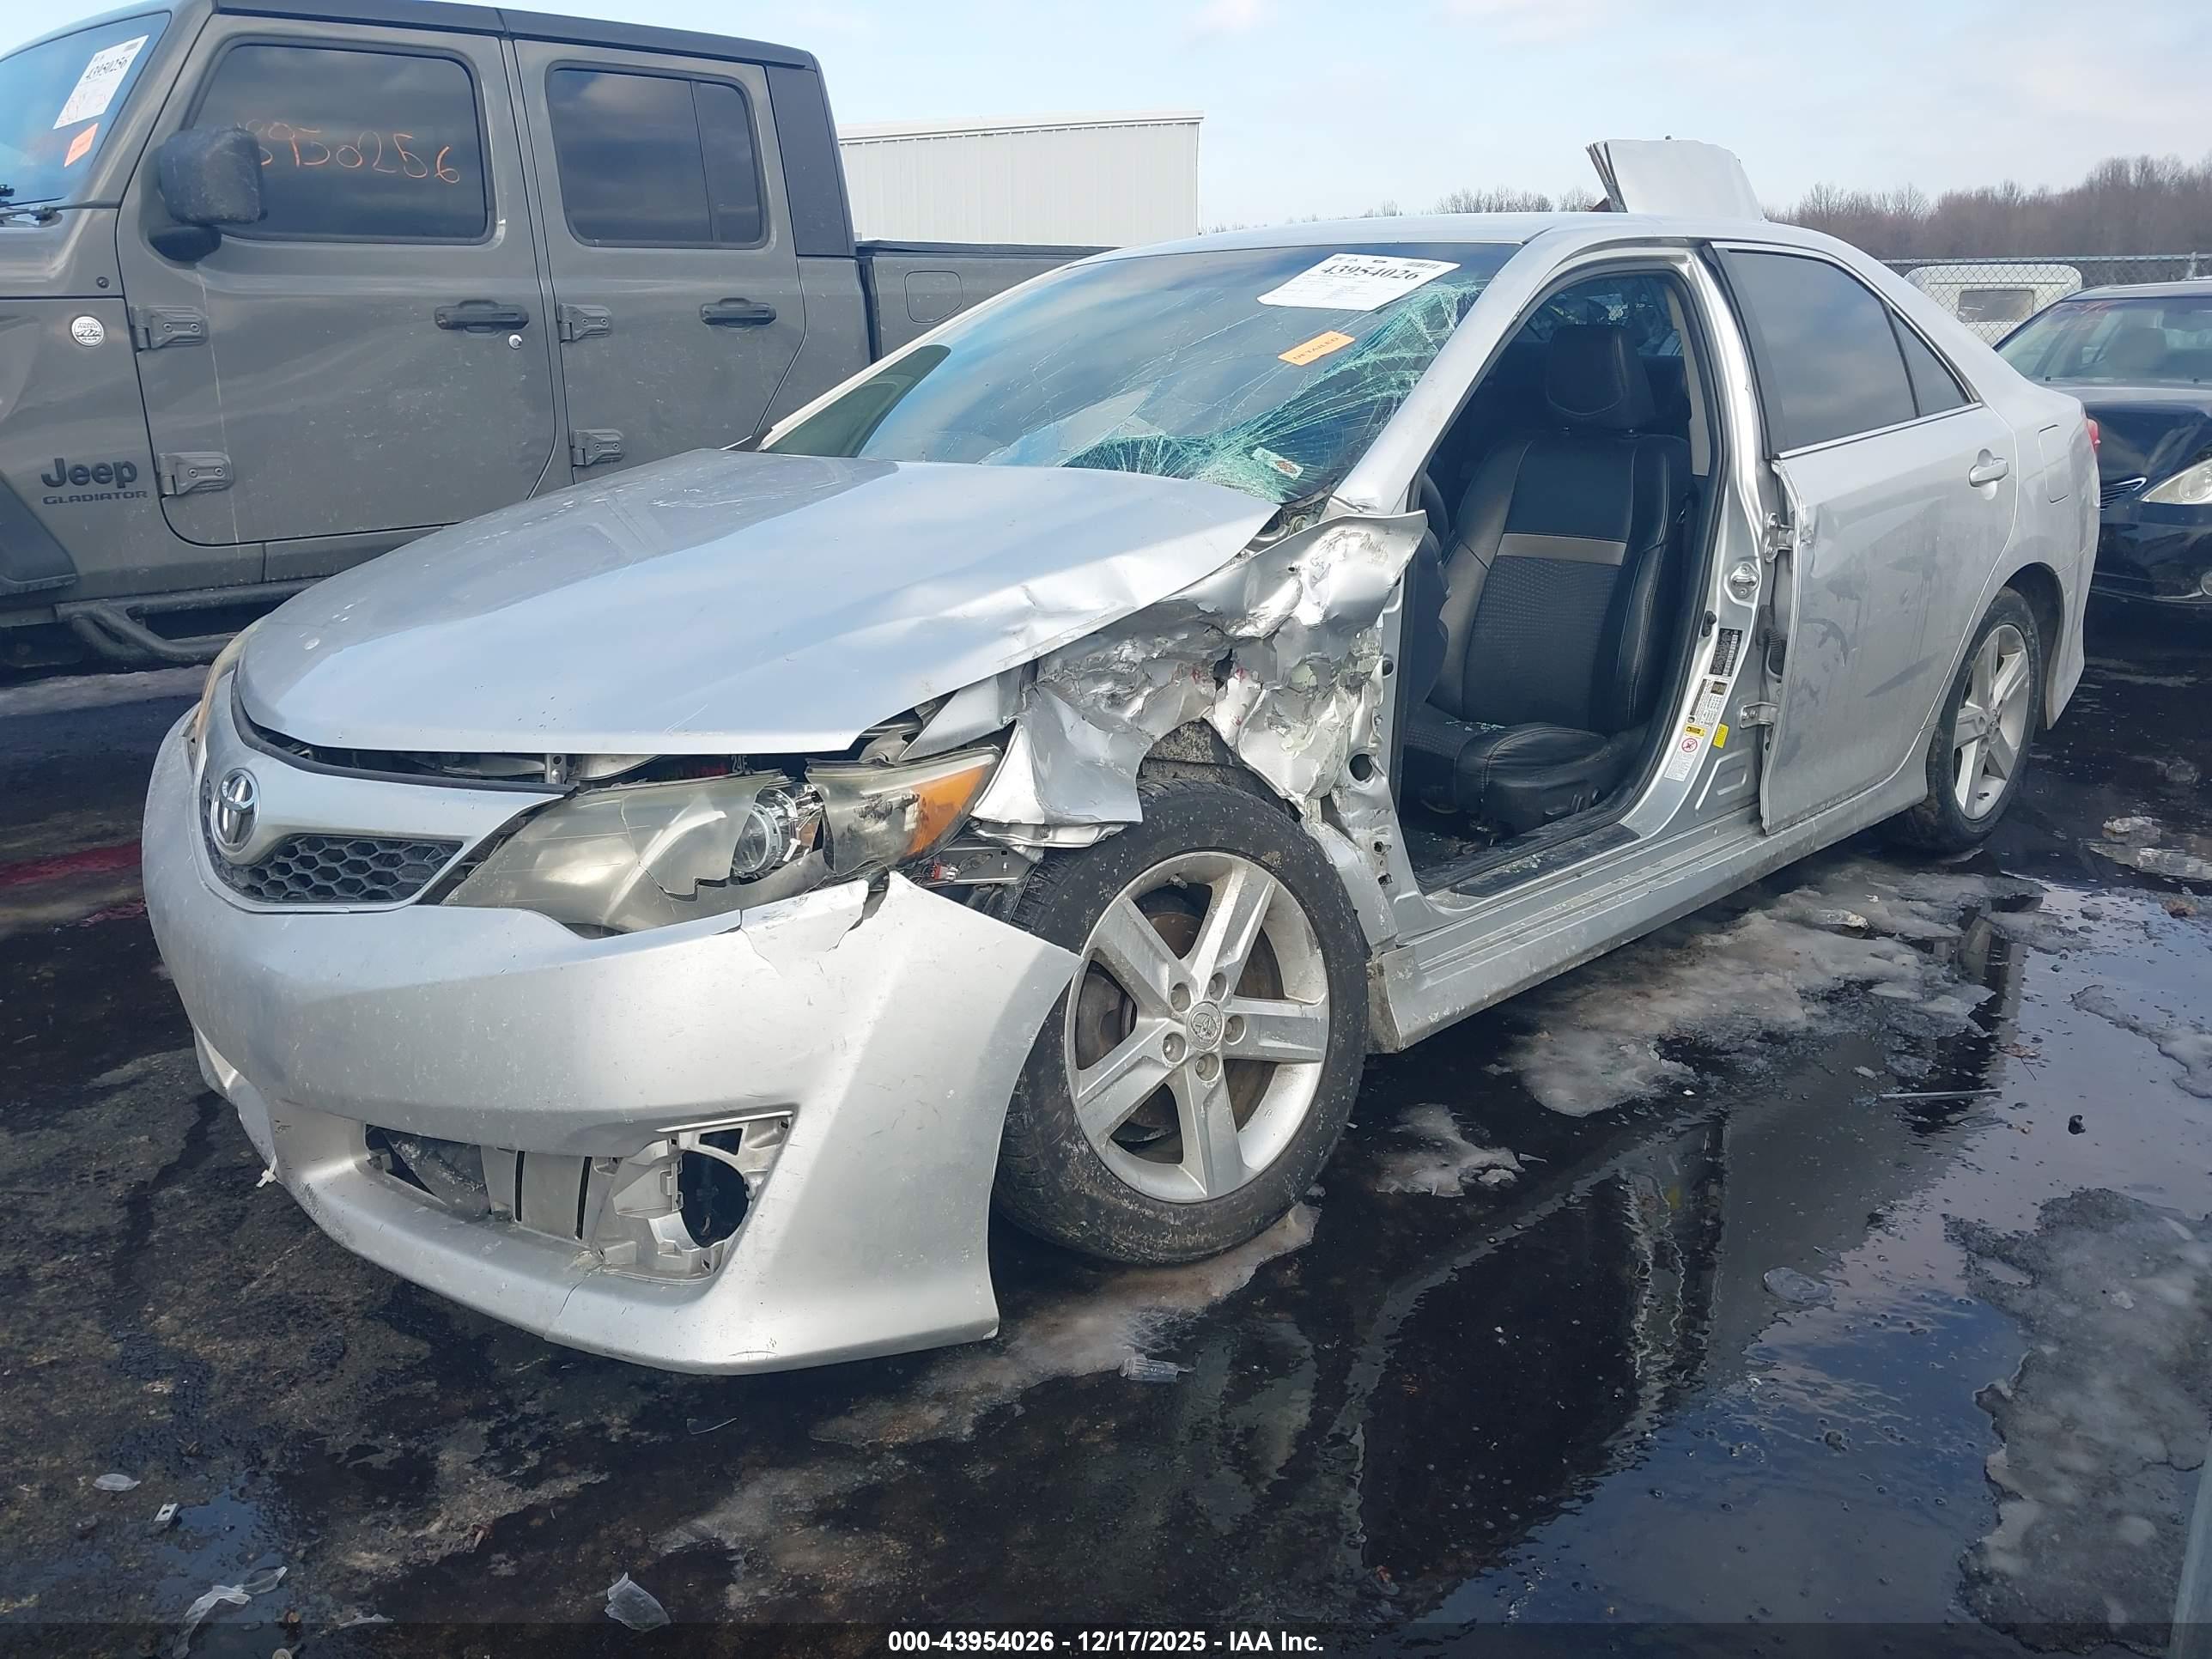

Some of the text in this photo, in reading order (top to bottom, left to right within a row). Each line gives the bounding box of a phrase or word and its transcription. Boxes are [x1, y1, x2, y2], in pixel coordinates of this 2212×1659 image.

[1320, 264, 1423, 281] 43954026
[1292, 337, 1340, 361] DETAILED
[41, 457, 137, 489] Jeep
[42, 490, 148, 505] GLADIATOR
